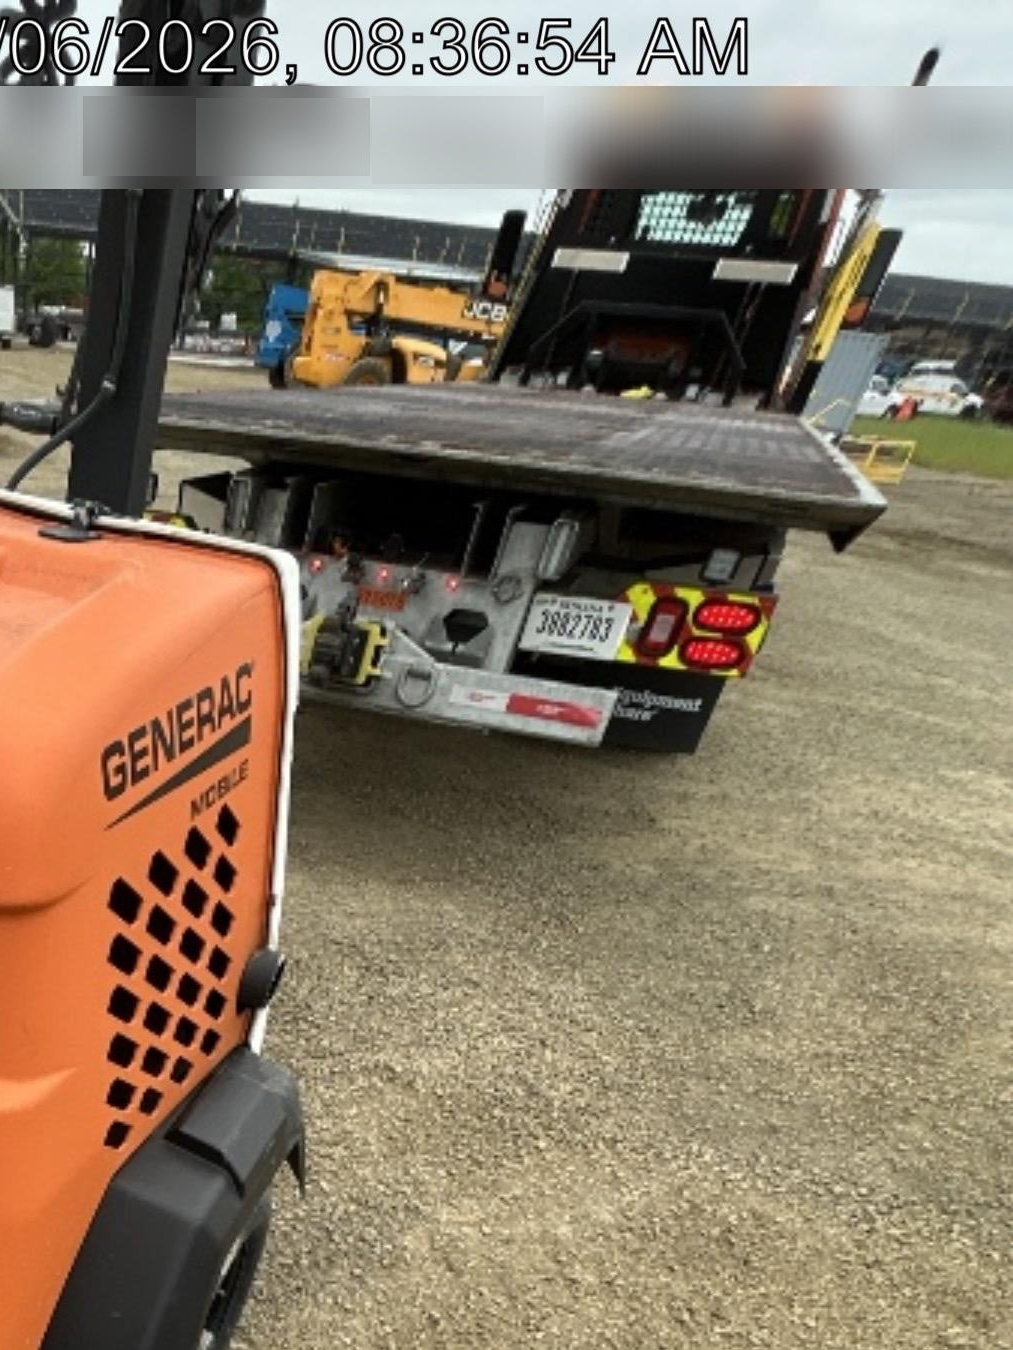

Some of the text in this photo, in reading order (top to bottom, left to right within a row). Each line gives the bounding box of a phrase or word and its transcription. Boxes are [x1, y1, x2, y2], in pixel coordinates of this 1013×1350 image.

[463, 301, 508, 323] JCB
[100, 661, 253, 802] GENERAC
[190, 757, 250, 822] MOBILE
